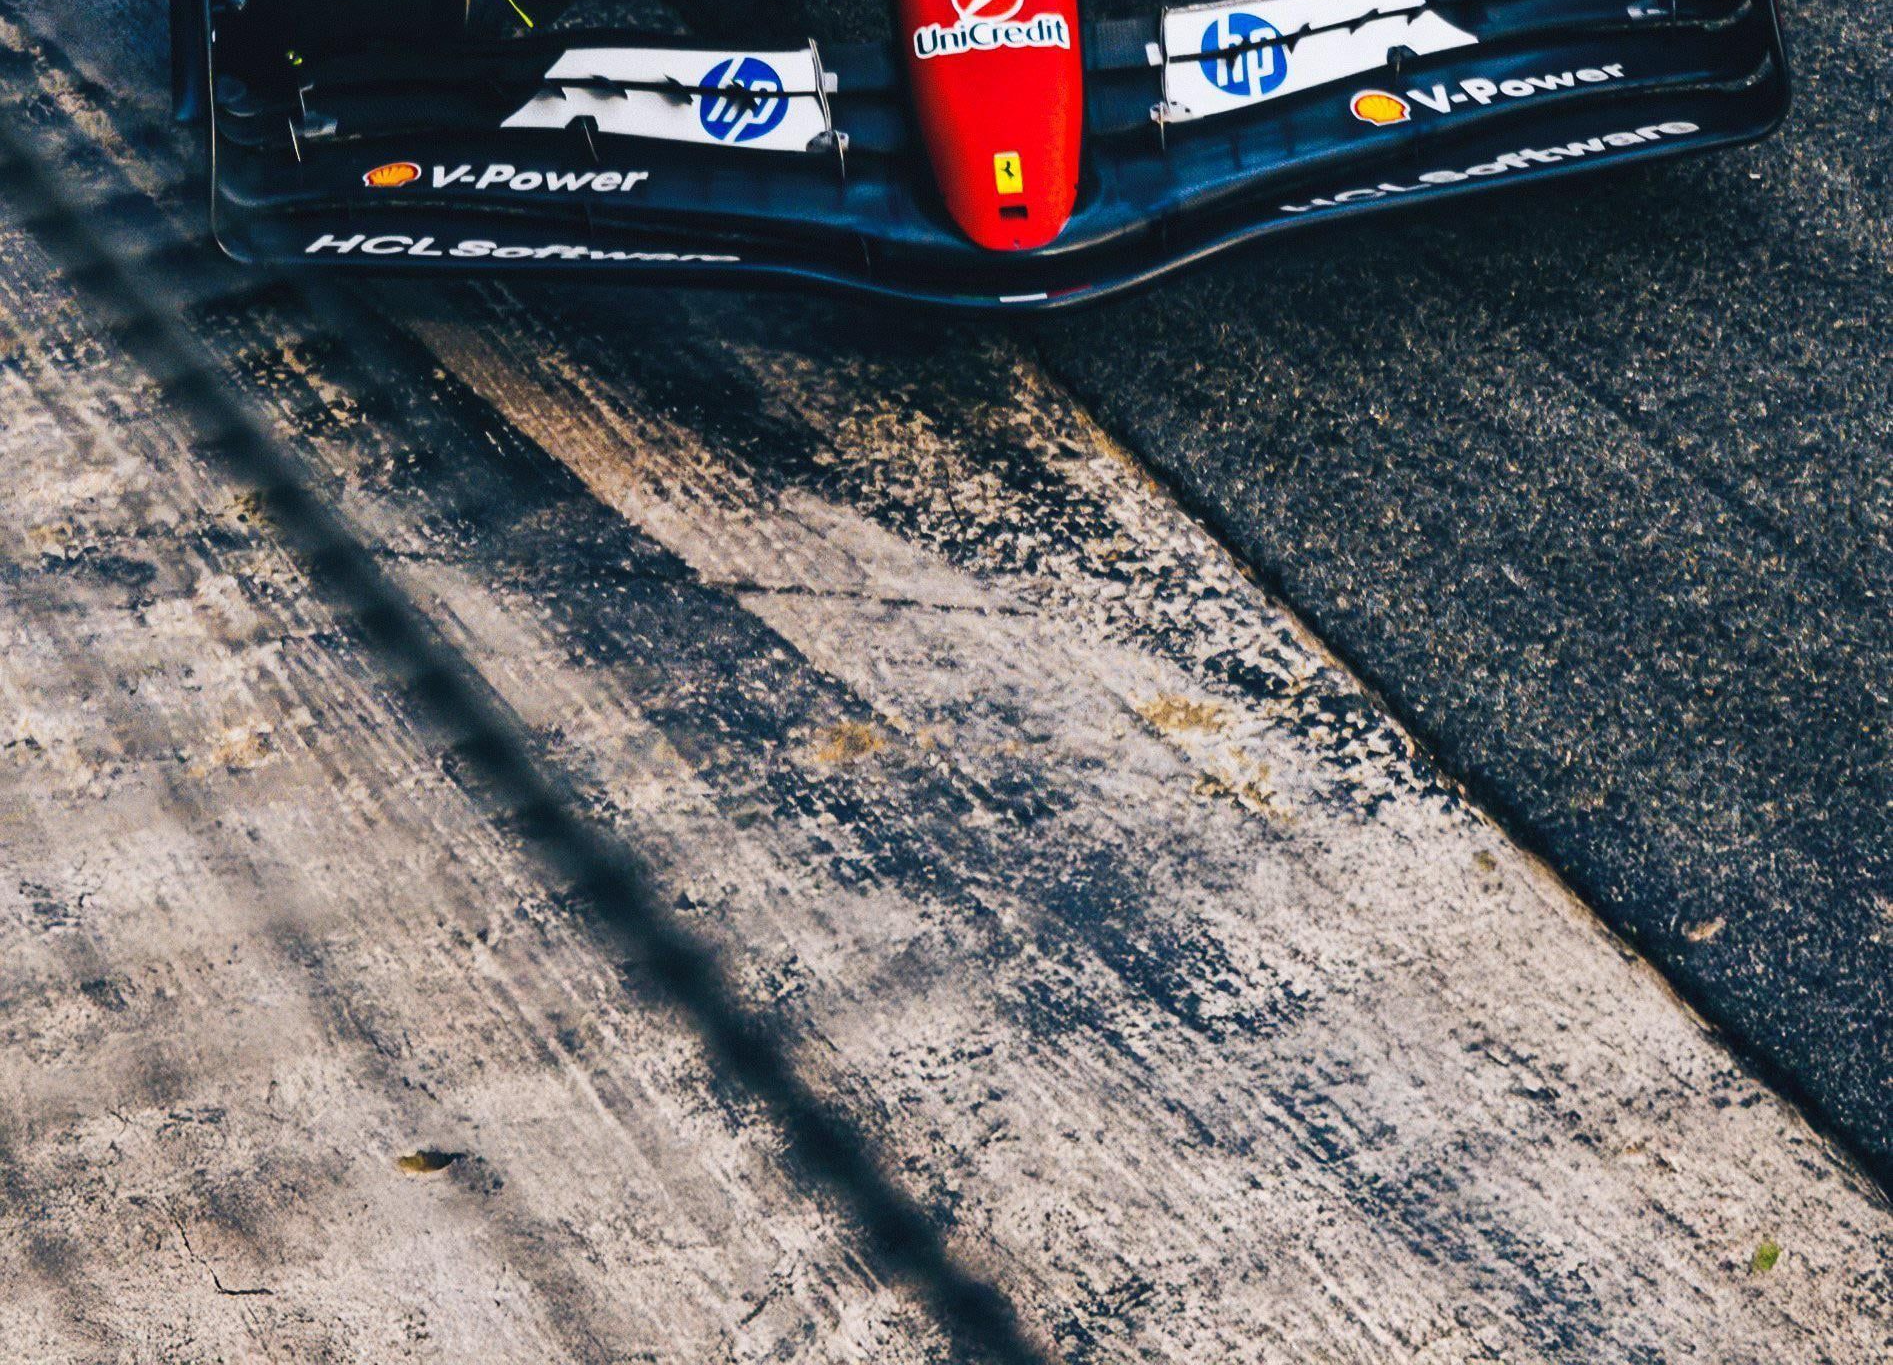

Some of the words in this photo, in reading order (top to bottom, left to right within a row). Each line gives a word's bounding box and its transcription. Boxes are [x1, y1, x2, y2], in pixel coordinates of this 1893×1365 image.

[915, 18, 1066, 56] UniCredit
[1216, 12, 1277, 99] hp
[706, 55, 780, 144] hp
[1406, 61, 1624, 115] V-Power
[431, 163, 648, 192] V-Power
